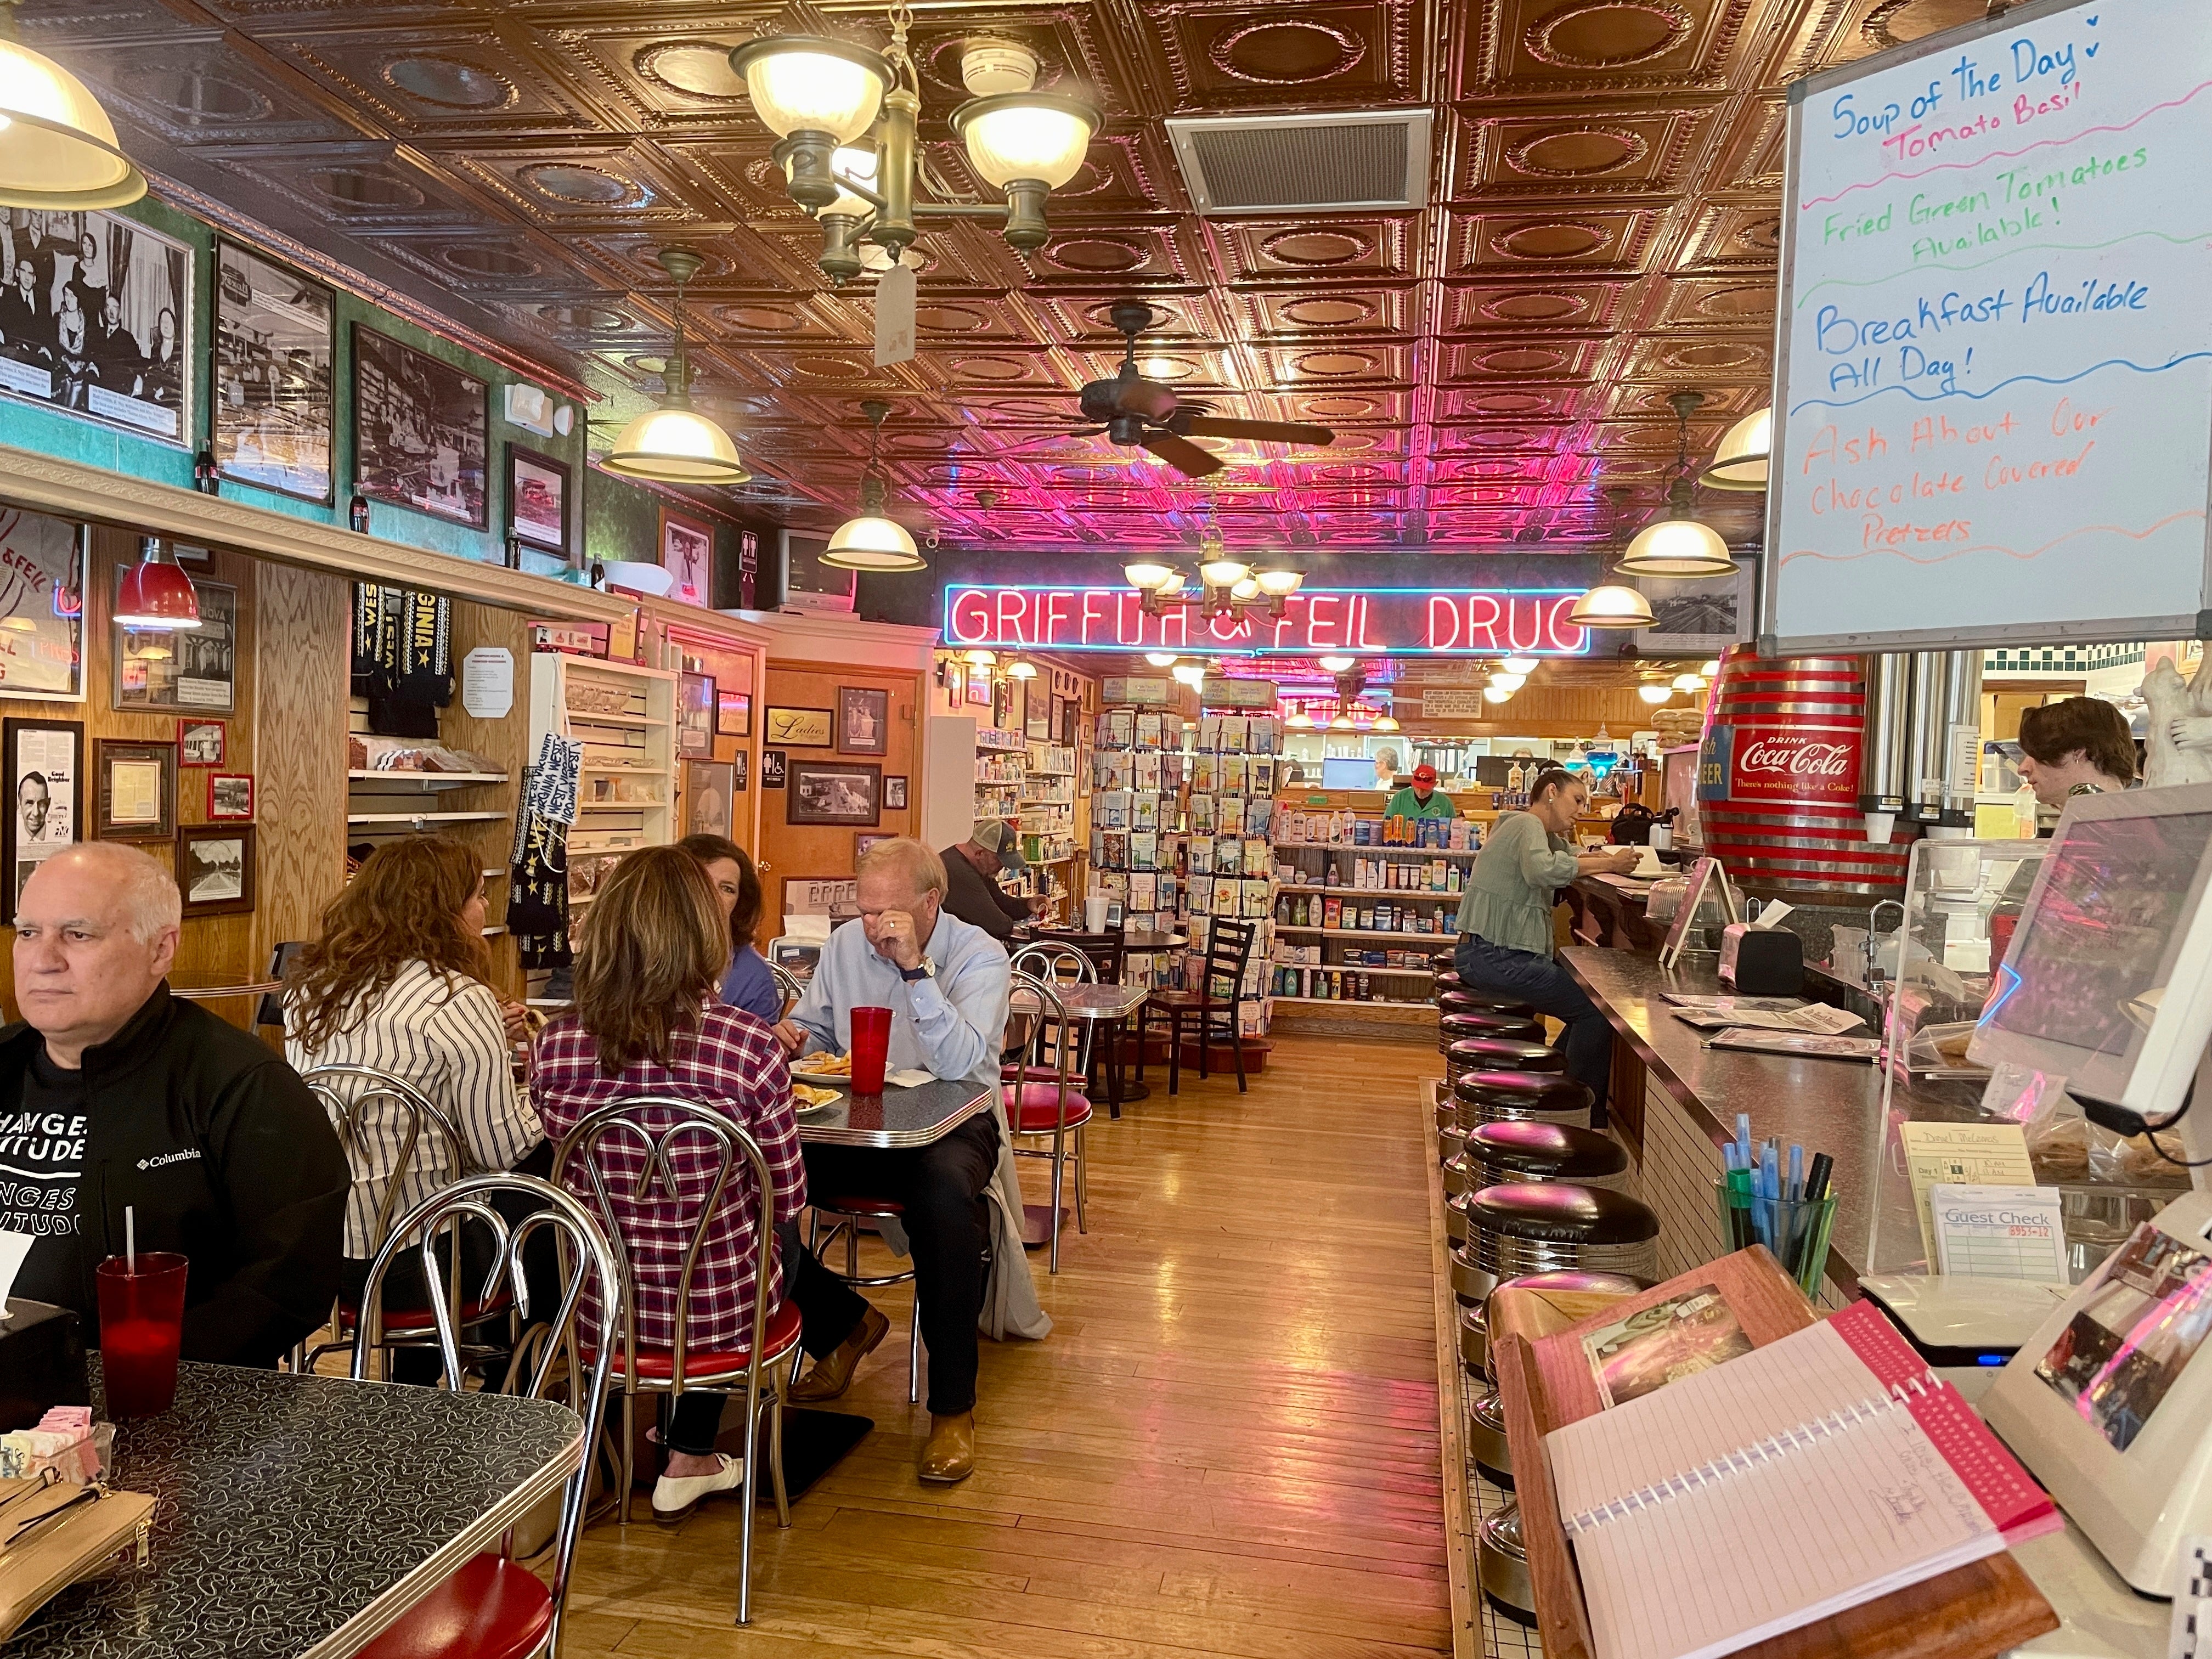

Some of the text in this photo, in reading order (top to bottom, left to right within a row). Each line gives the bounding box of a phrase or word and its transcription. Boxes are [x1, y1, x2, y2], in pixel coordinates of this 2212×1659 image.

[1833, 94, 1900, 138] Soup
[1911, 81, 1943, 119] of
[2011, 39, 2076, 84] Day
[1883, 82, 2080, 160] Tomato Basil
[1824, 147, 2147, 245] Fried Green Tomatoes
[1816, 272, 2148, 354] Breakfast Available
[1830, 357, 1880, 391] All
[1910, 411, 2021, 453] About
[2052, 397, 2109, 436] Our
[1984, 441, 2095, 490] Covered
[1862, 514, 1972, 548] Pretzels
[365, 584, 377, 627] WES
[415, 593, 436, 647] GINIA
[1273, 596, 1387, 651] FEIL
[1429, 595, 1585, 651] DRUG
[771, 714, 825, 739] Ladies
[548, 738, 562, 771] WEST
[567, 746, 580, 778] WEST
[1740, 742, 1854, 775] Coca-Cola
[1700, 763, 1723, 785] EER
[1735, 778, 1762, 788] There's
[1764, 781, 1799, 793] nothing
[1801, 782, 1818, 791] like
[1827, 782, 1854, 792] Coke!
[548, 785, 568, 814] WEST
[0, 1111, 87, 1136] HANGE
[0, 1136, 86, 1161] ITUDE
[150, 1148, 201, 1167] Columbia
[1918, 1167, 1932, 1175] Day
[0, 1181, 76, 1210] NGES
[1945, 1209, 2050, 1225] Guest Check
